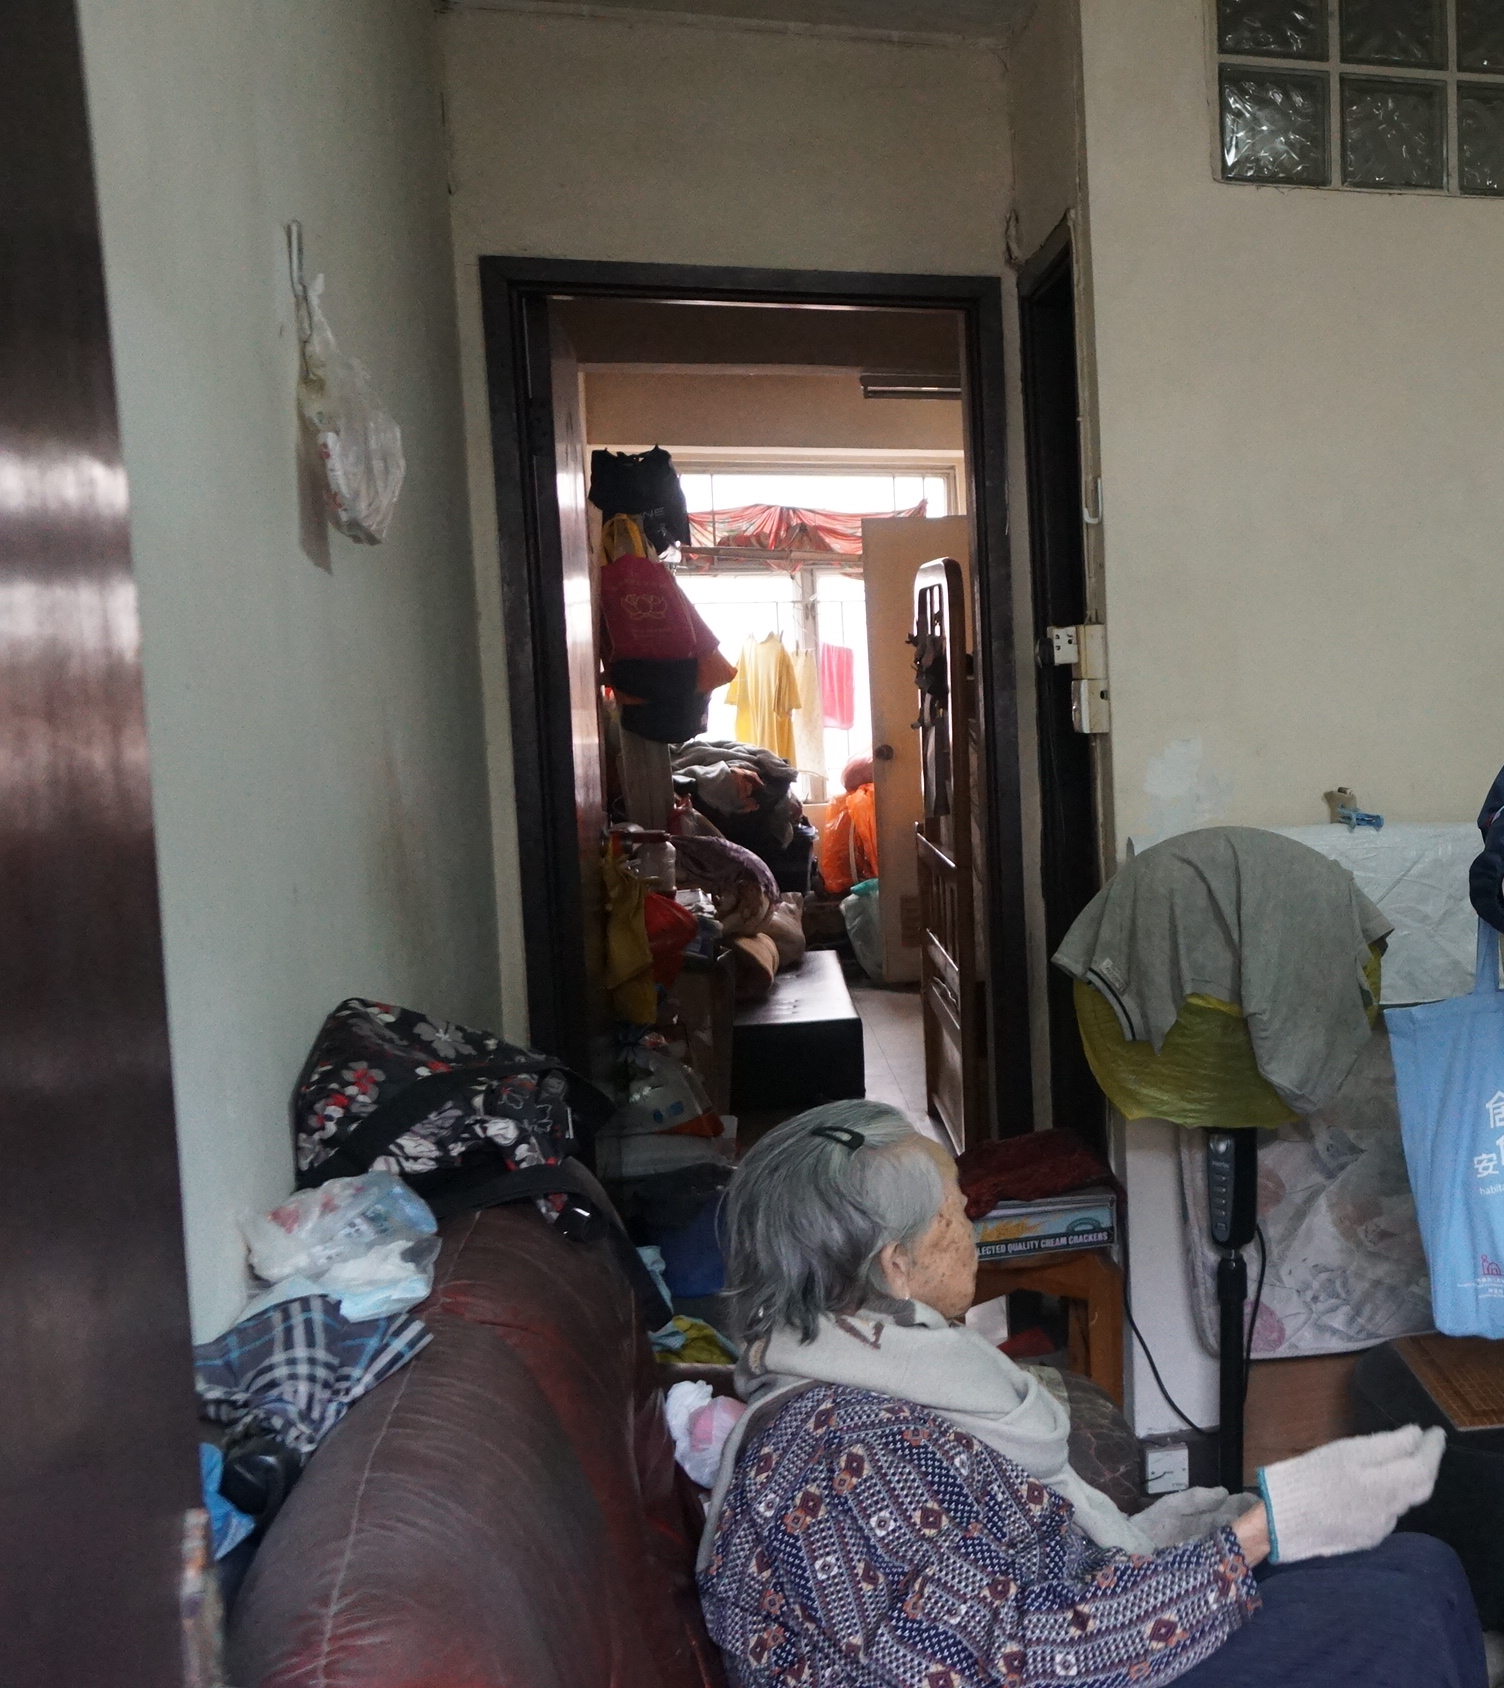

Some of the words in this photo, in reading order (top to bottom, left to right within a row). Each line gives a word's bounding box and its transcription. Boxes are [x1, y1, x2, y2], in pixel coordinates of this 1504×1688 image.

[1007, 1240, 1040, 1254] QUALITY
[1040, 1236, 1067, 1248] CREAM
[1068, 1231, 1108, 1245] CRACKERS
